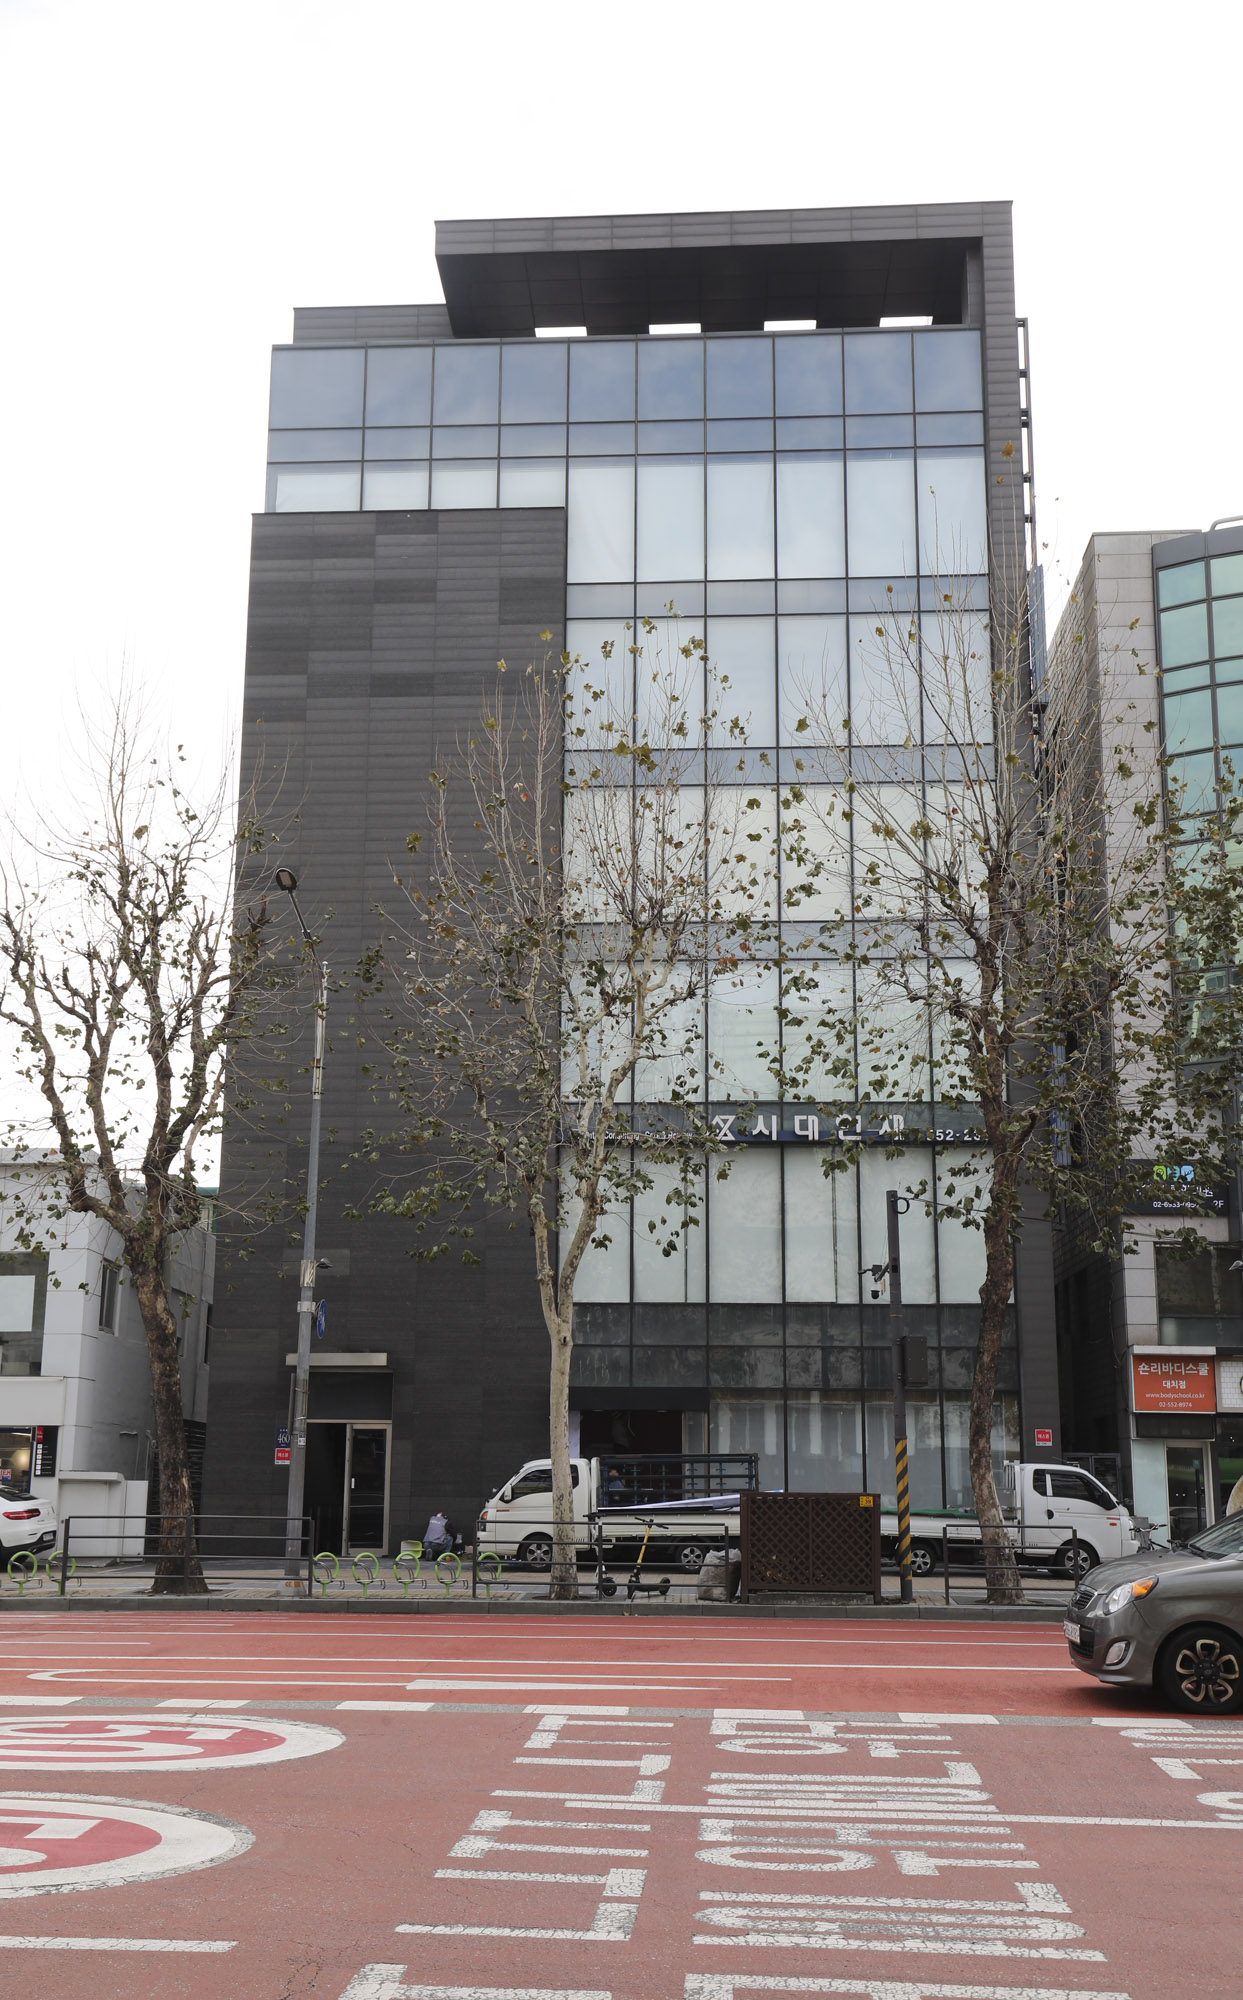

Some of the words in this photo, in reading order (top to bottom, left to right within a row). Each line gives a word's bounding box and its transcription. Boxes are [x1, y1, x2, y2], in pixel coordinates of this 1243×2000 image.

[752, 1113, 905, 1141] 시대인재
[1138, 1362, 1209, 1376] 숀리바디스쿨
[1162, 1380, 1187, 1390] 대치점
[1145, 1392, 1205, 1400] www.bodyschool.co.kr
